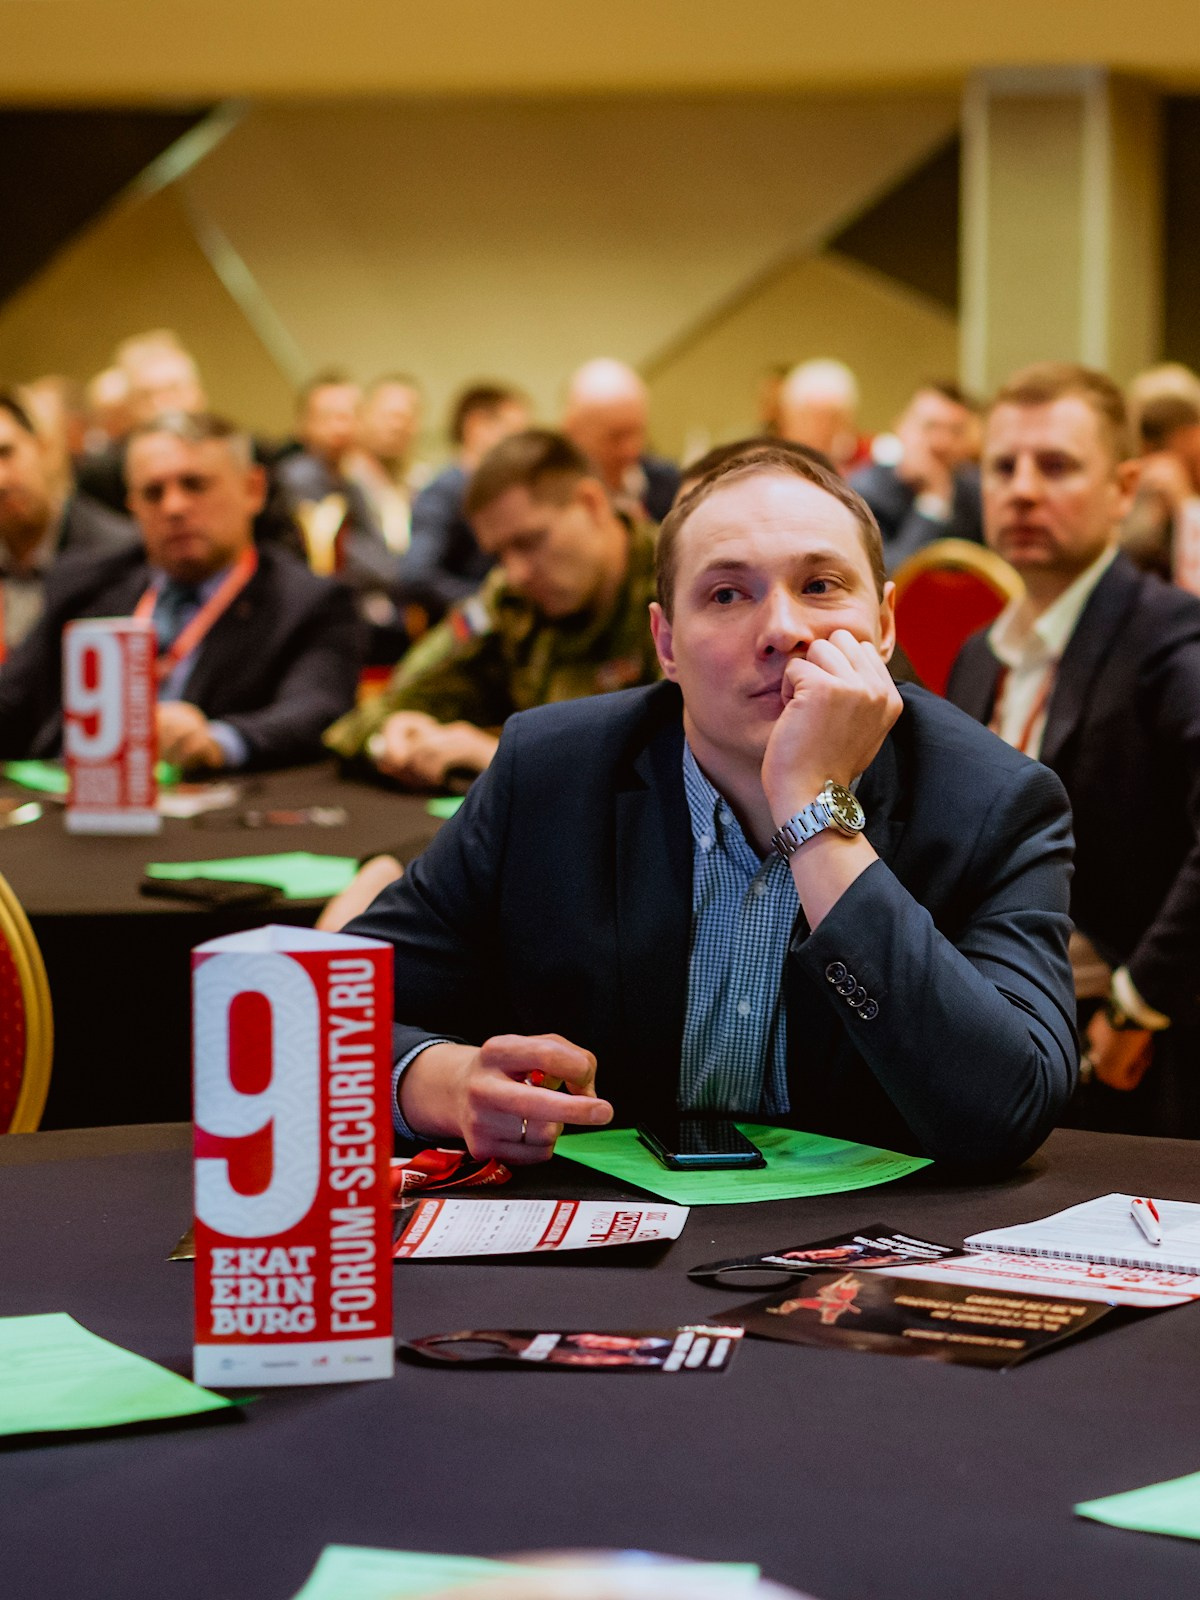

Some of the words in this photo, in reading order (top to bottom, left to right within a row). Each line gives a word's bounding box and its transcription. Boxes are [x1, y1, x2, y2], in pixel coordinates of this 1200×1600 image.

[62, 624, 123, 760] 9
[193, 951, 321, 1238] 9
[329, 957, 377, 1333] FORUM-SECURITY.RU
[210, 1246, 317, 1276] EKAT
[210, 1275, 317, 1306] ERIN
[210, 1305, 317, 1336] BURG
